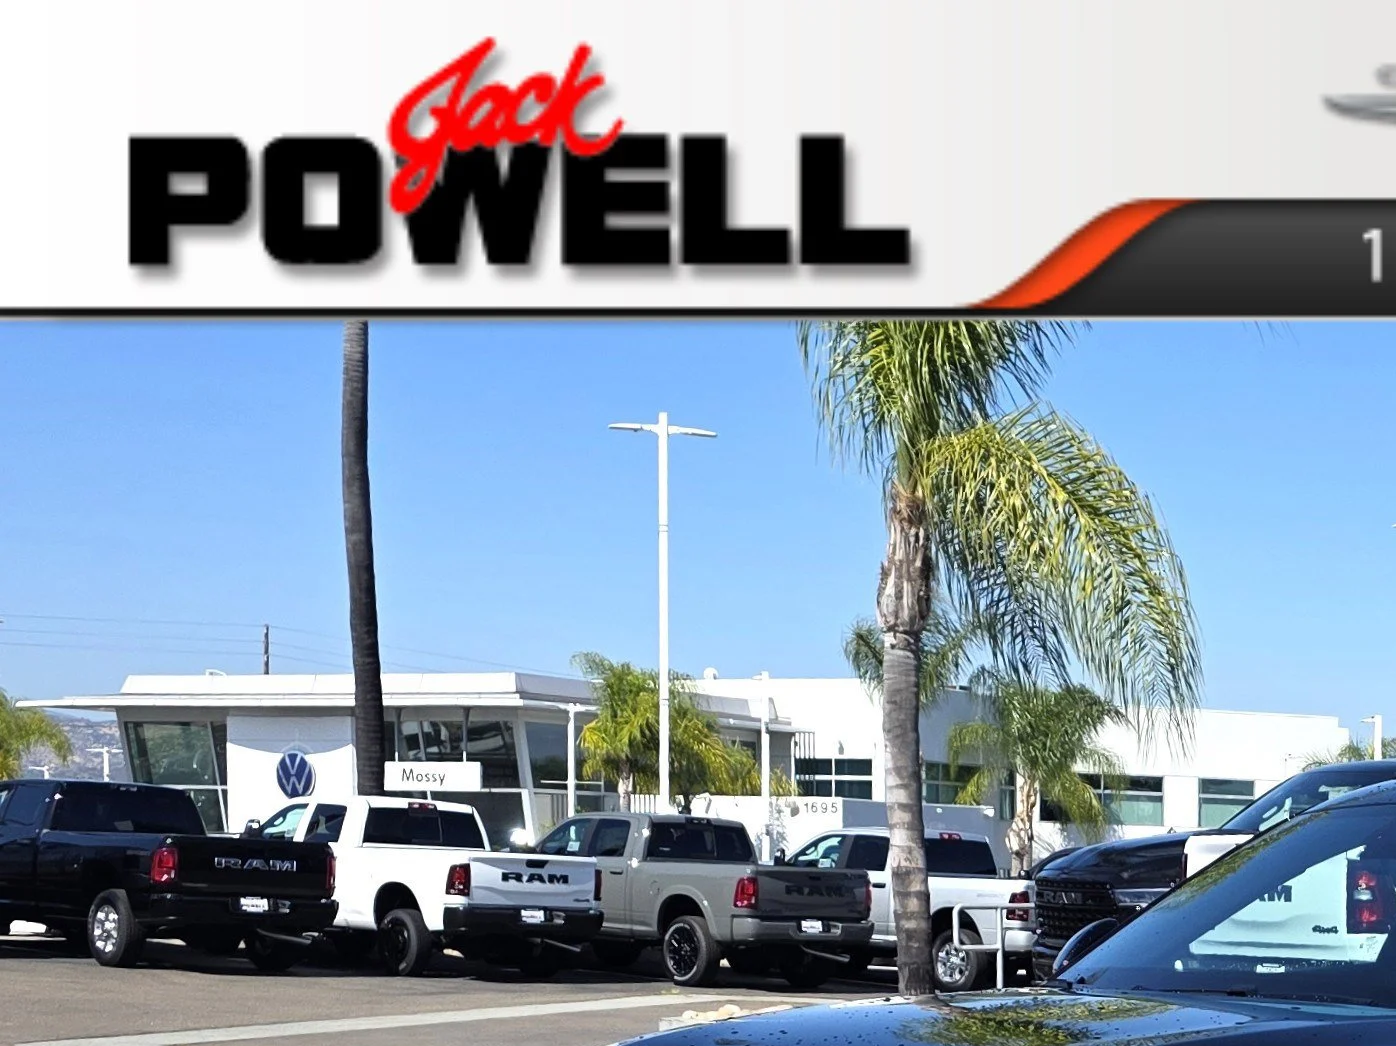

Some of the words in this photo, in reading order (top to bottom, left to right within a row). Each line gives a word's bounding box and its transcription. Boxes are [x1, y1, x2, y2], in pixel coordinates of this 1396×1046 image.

[401, 768, 446, 786] Mossy
[804, 801, 838, 814] 1695
[214, 857, 297, 872] RAM
[501, 871, 569, 884] RAM
